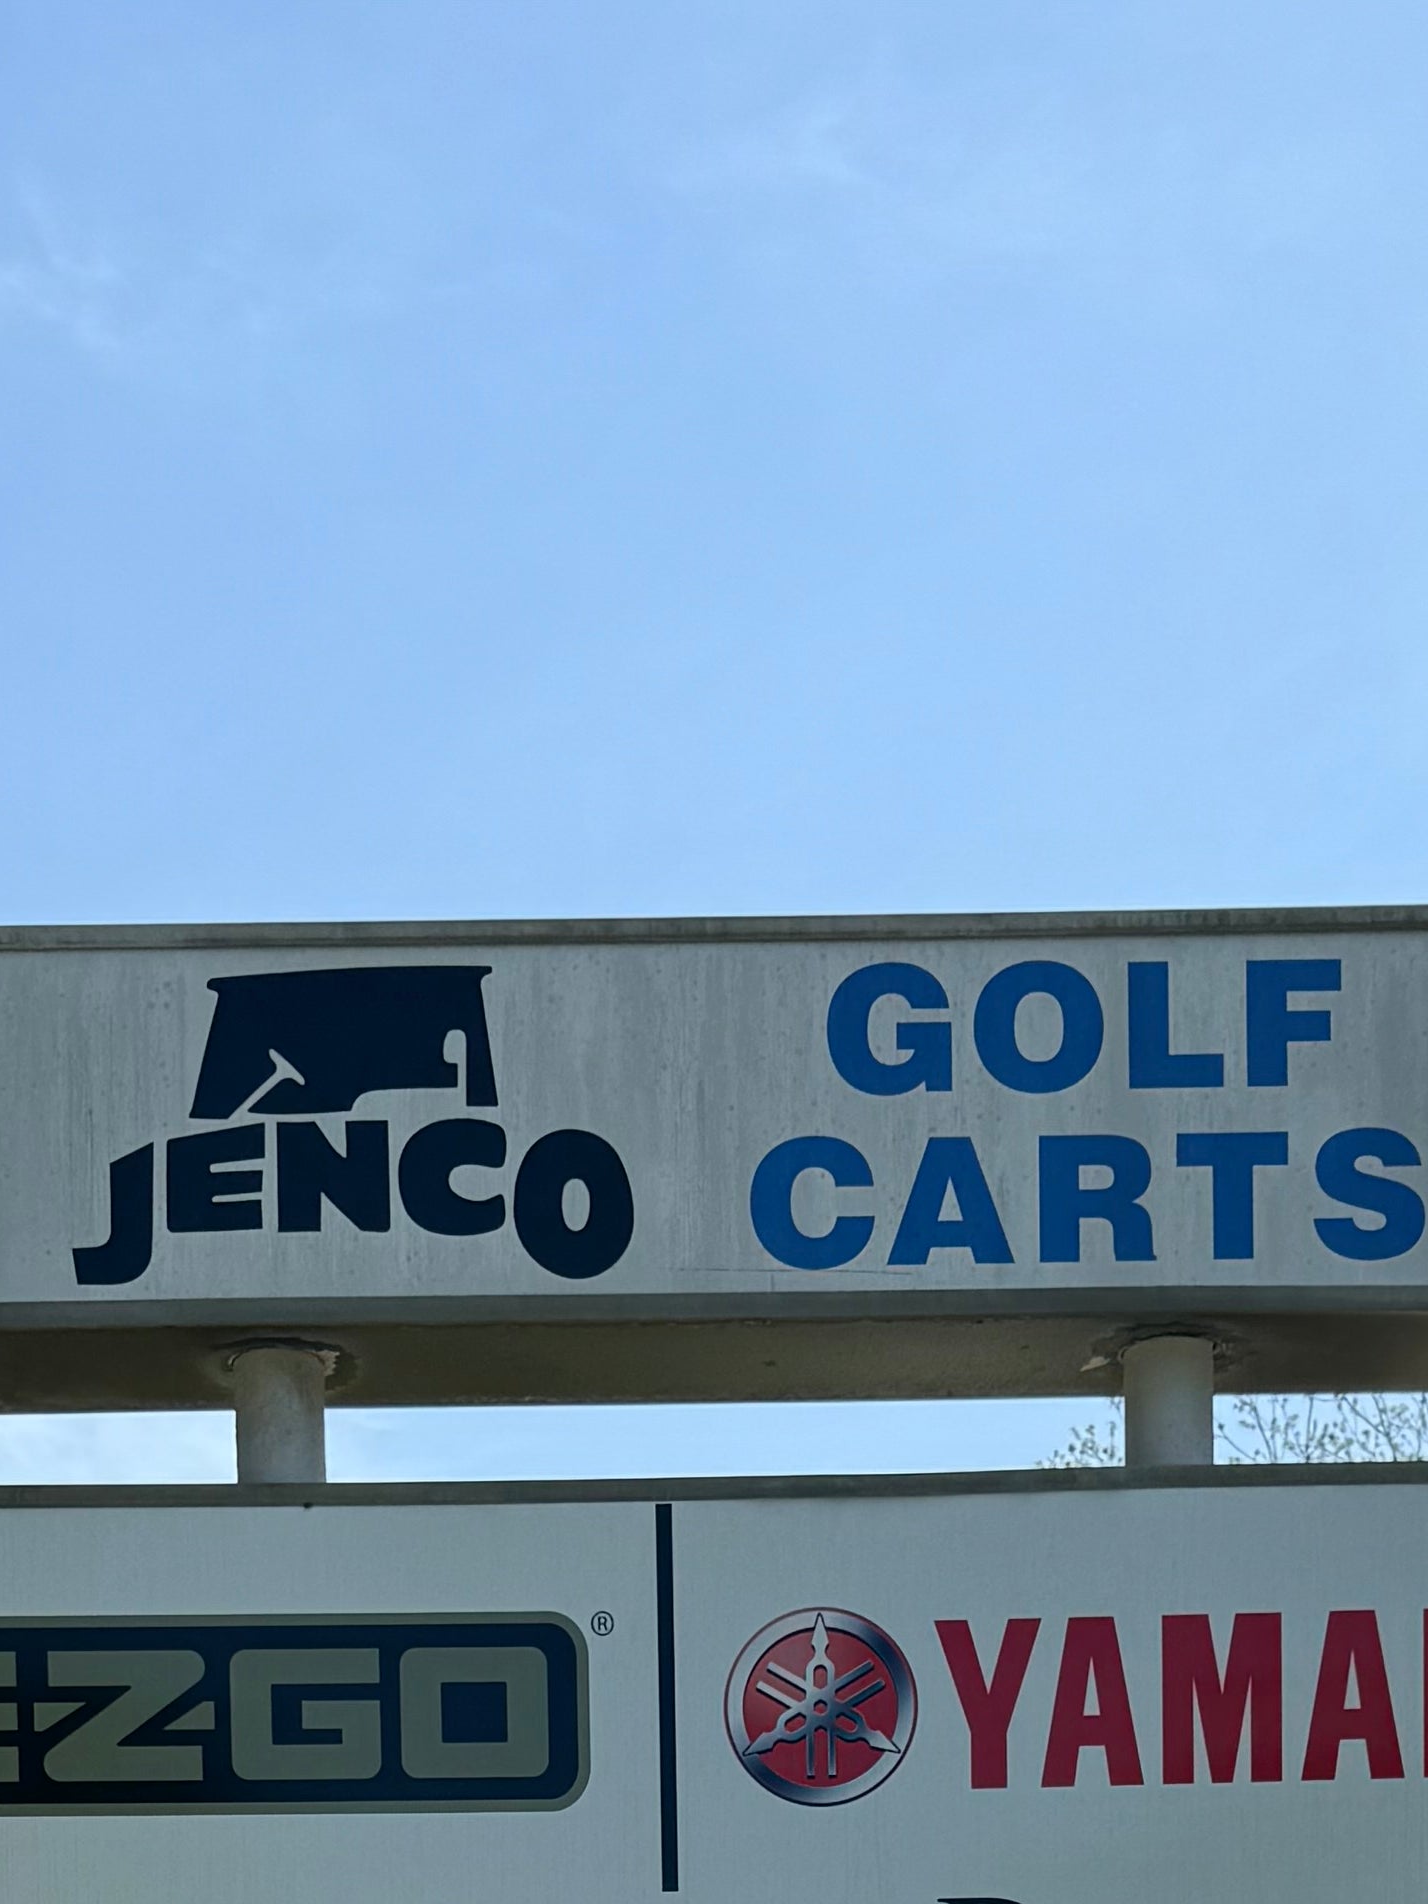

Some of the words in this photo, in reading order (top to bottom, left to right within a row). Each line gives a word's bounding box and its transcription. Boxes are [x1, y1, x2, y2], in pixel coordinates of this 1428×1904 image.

[827, 960, 1341, 1095] GOLF
[72, 1118, 635, 1286] JENCO
[750, 1128, 1425, 1271] CARTS
